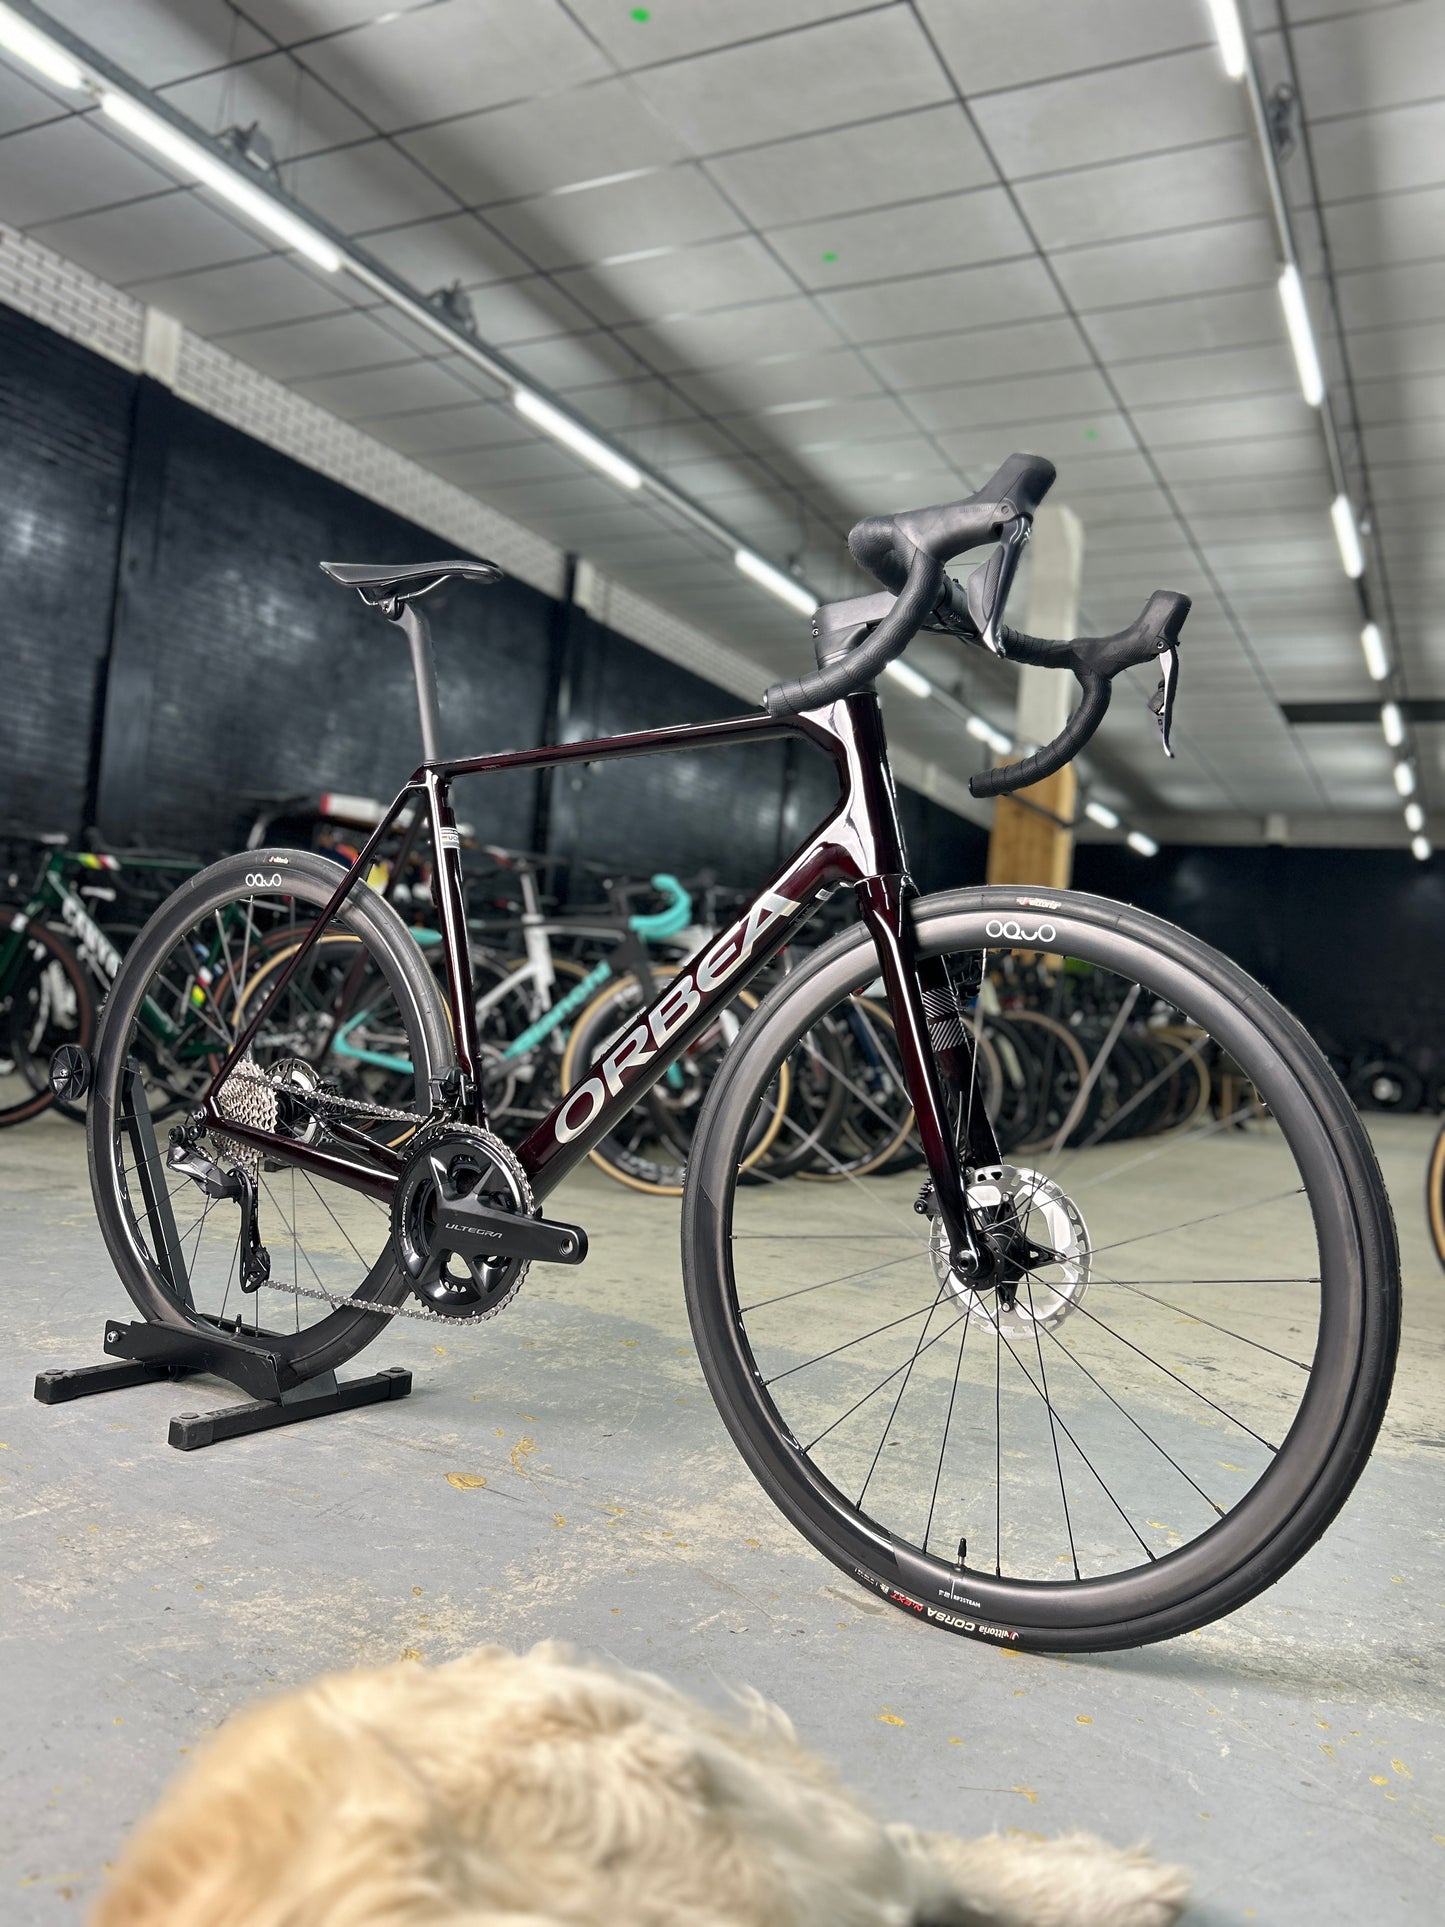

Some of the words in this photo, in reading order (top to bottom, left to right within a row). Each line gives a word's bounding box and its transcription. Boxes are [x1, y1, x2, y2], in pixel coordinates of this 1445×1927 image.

[555, 889, 801, 1144] ORBEA
[445, 1222, 504, 1239] ULTEGRA
[927, 1607, 976, 1632] CORSA
[978, 1625, 1010, 1640] vittoria
